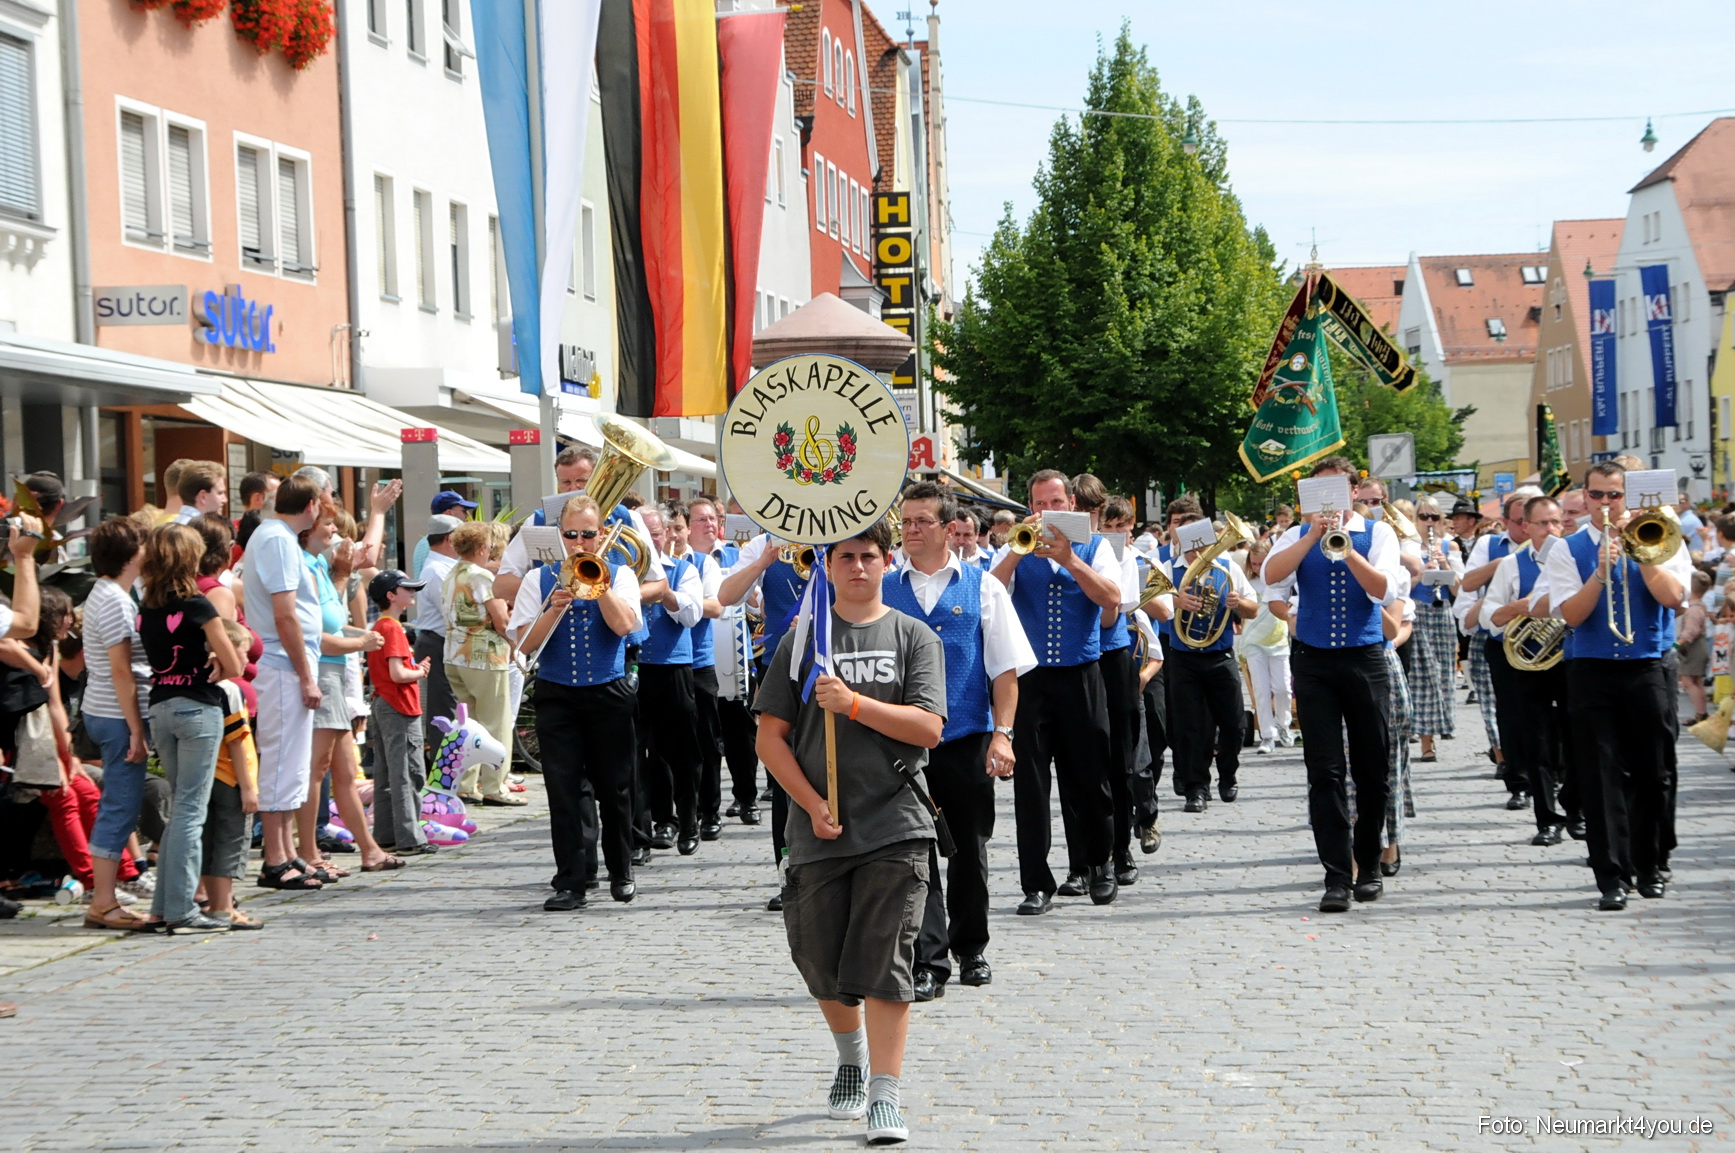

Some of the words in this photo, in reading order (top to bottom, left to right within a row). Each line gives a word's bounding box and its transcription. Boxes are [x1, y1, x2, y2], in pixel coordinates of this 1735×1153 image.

[97, 292, 181, 317] sutor.
[731, 361, 897, 438] BLASKAPELLE
[756, 490, 878, 537] DEINING
